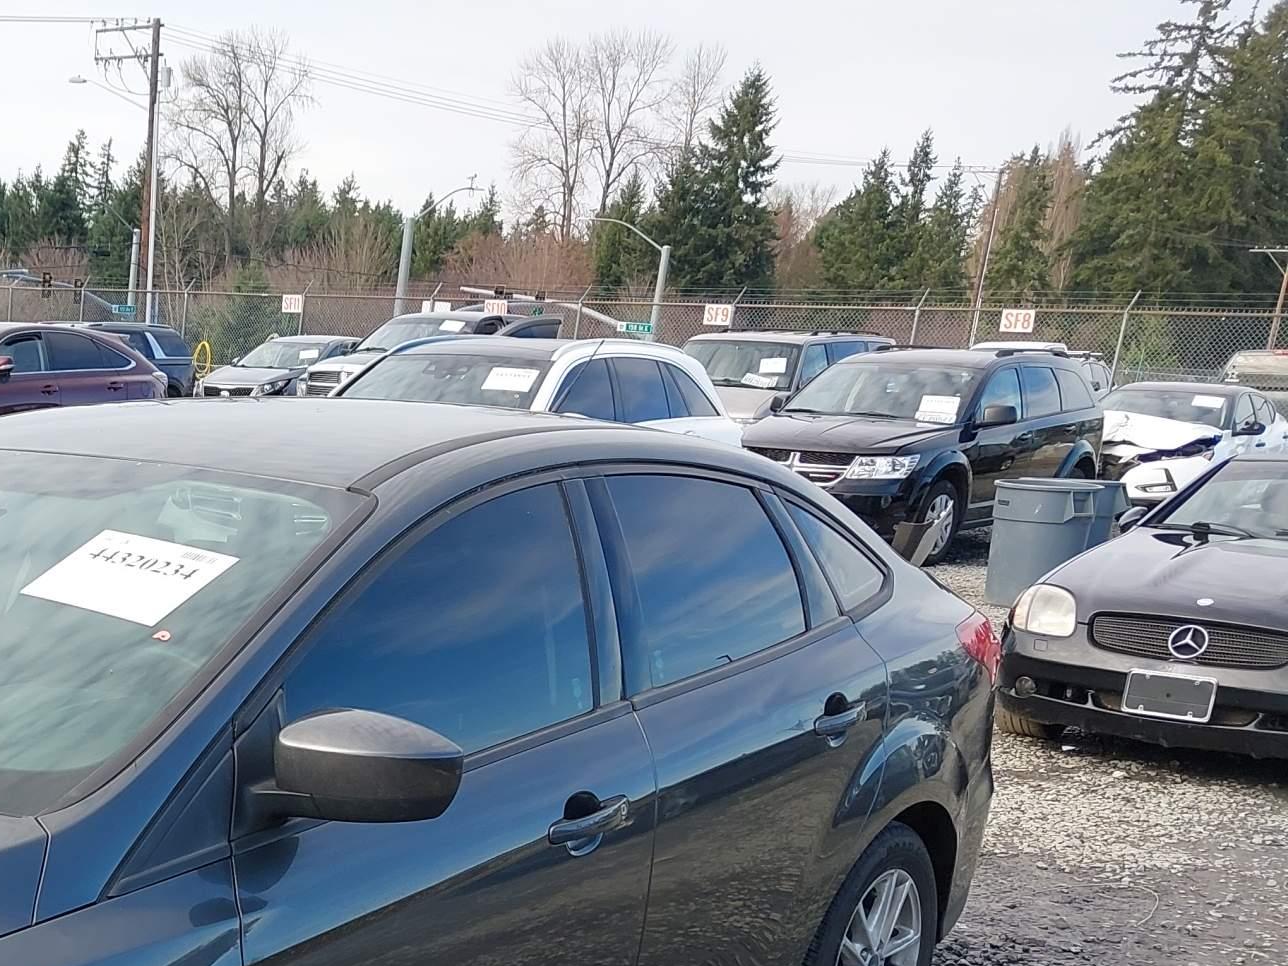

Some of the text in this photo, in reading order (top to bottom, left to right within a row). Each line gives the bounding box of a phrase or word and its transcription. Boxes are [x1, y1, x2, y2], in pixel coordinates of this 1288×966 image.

[284, 296, 300, 311] SF11
[706, 306, 729, 322] SF9
[1003, 312, 1032, 329] SF8
[88, 547, 200, 580] 44320234
